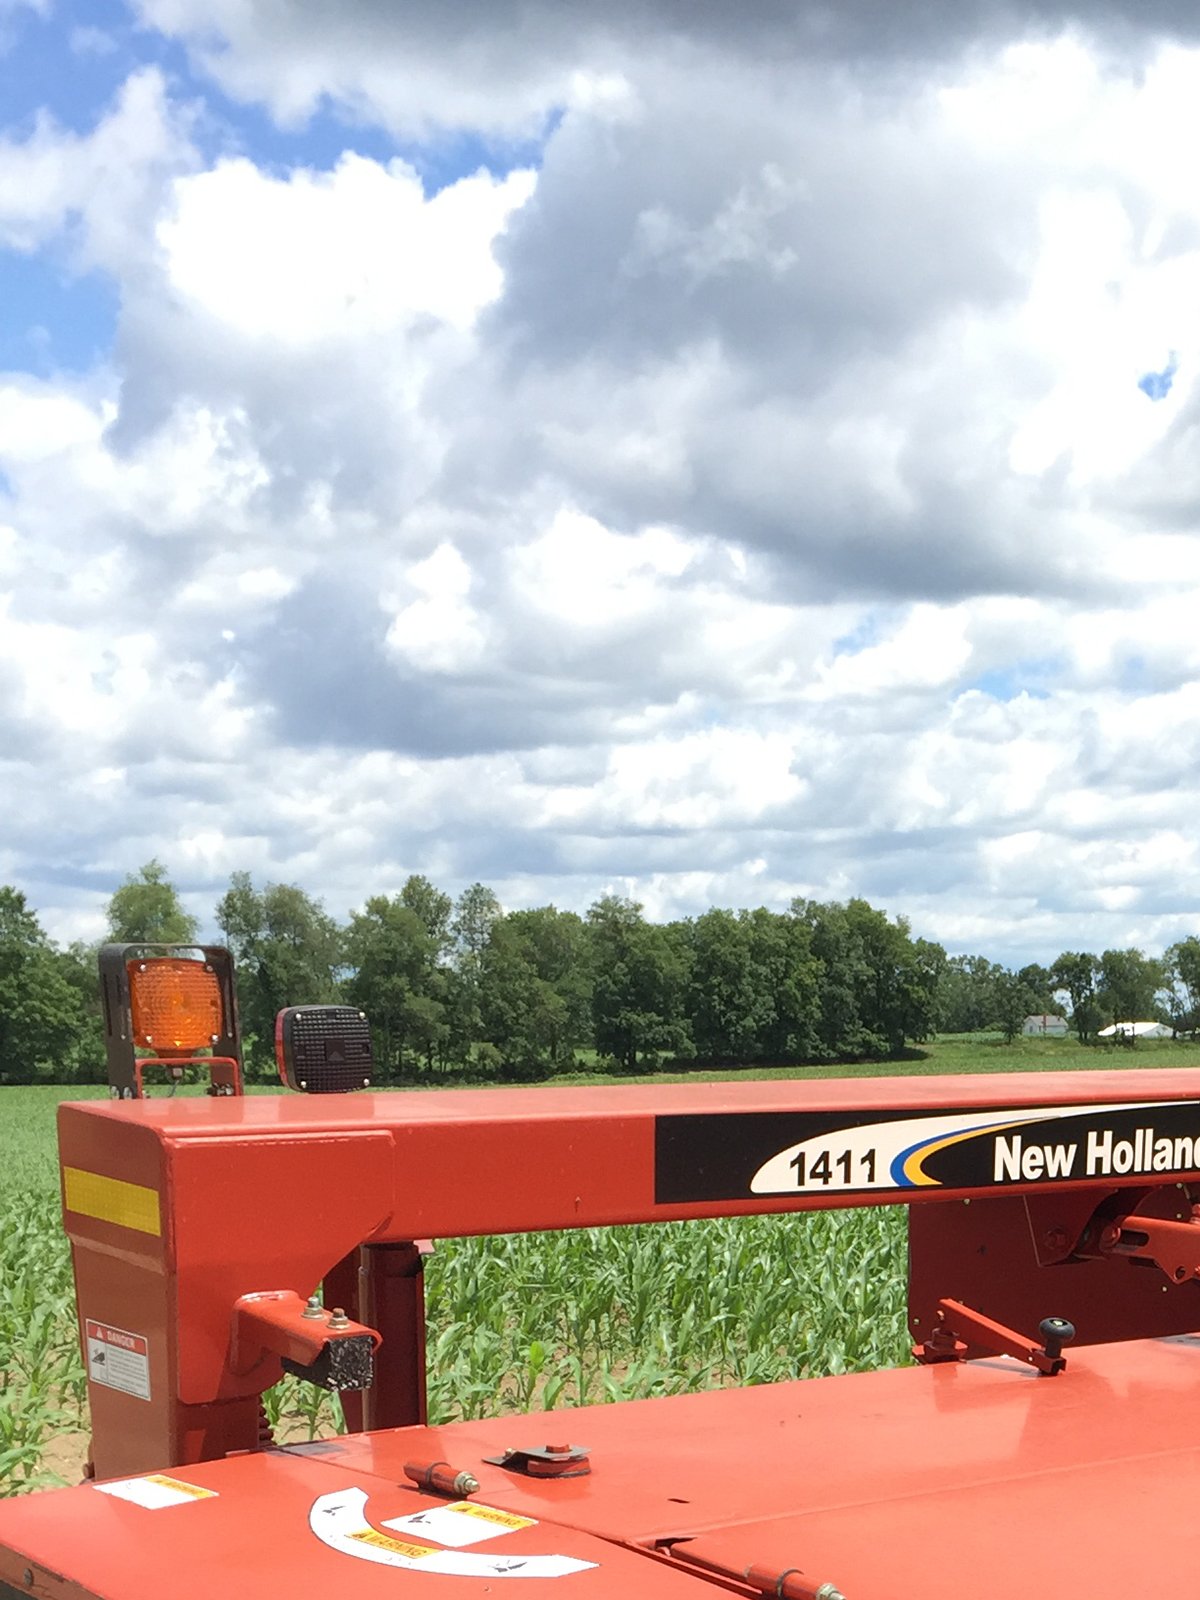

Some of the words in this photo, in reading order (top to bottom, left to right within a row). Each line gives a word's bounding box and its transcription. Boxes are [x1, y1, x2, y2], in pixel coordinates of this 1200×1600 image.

[789, 1148, 877, 1188] 1411
[993, 1134, 1078, 1182] New
[106, 1330, 136, 1349] DANGER
